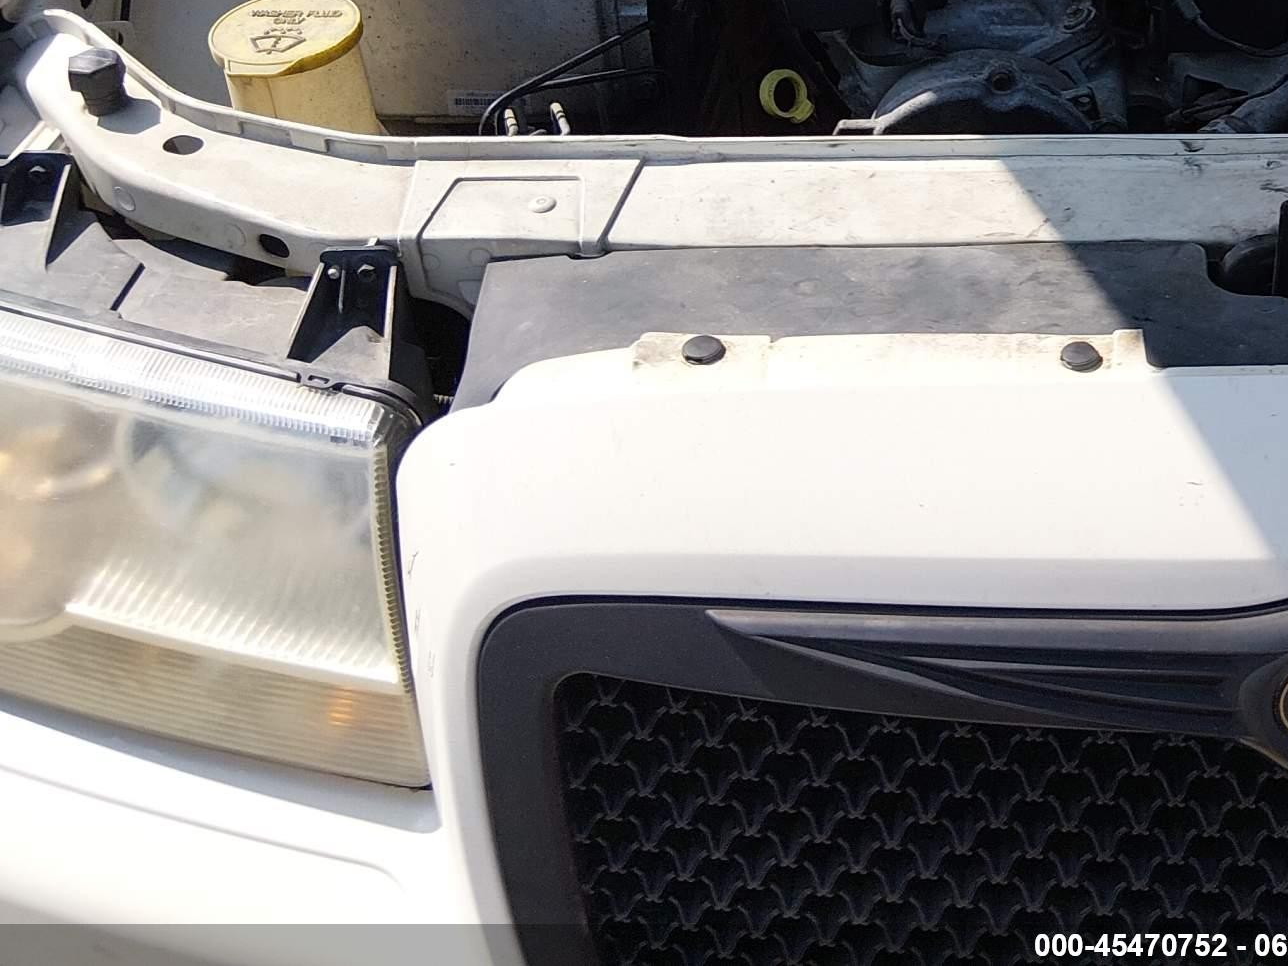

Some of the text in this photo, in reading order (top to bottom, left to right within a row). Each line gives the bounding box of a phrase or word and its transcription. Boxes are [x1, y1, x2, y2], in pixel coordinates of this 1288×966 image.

[250, 9, 344, 18] WASHER FLUID
[273, 17, 306, 25] ONLY
